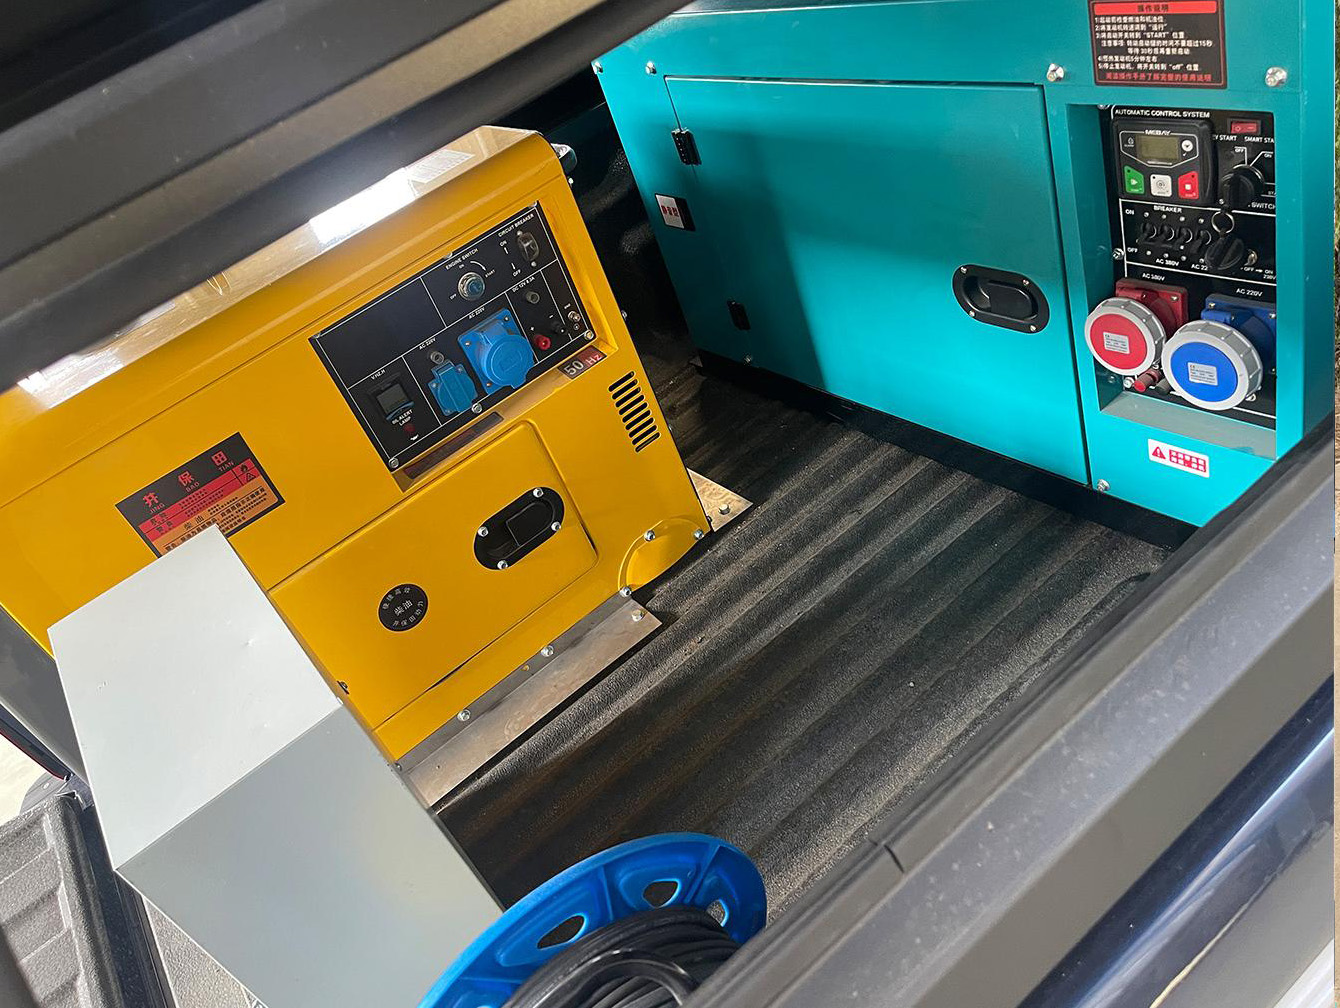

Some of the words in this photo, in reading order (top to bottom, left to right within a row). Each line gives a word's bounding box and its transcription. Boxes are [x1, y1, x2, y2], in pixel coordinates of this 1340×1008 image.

[1115, 109, 1150, 117] AUTOMATIC
[1151, 110, 1182, 118] CONTROL
[1153, 205, 1182, 213] BREAKER
[498, 225, 515, 237] CIRCUIT
[514, 213, 534, 228] BREAKER
[445, 258, 462, 270] ENGINE
[461, 248, 478, 260] SWITCH
[1246, 289, 1263, 297] 220V
[563, 360, 584, 375] 50
[585, 354, 602, 368] Hz
[399, 409, 413, 420] ALERT
[399, 416, 411, 426] LAMP
[186, 481, 200, 492] BAO
[218, 461, 235, 472] TIAN
[394, 600, 413, 616] 柴油
